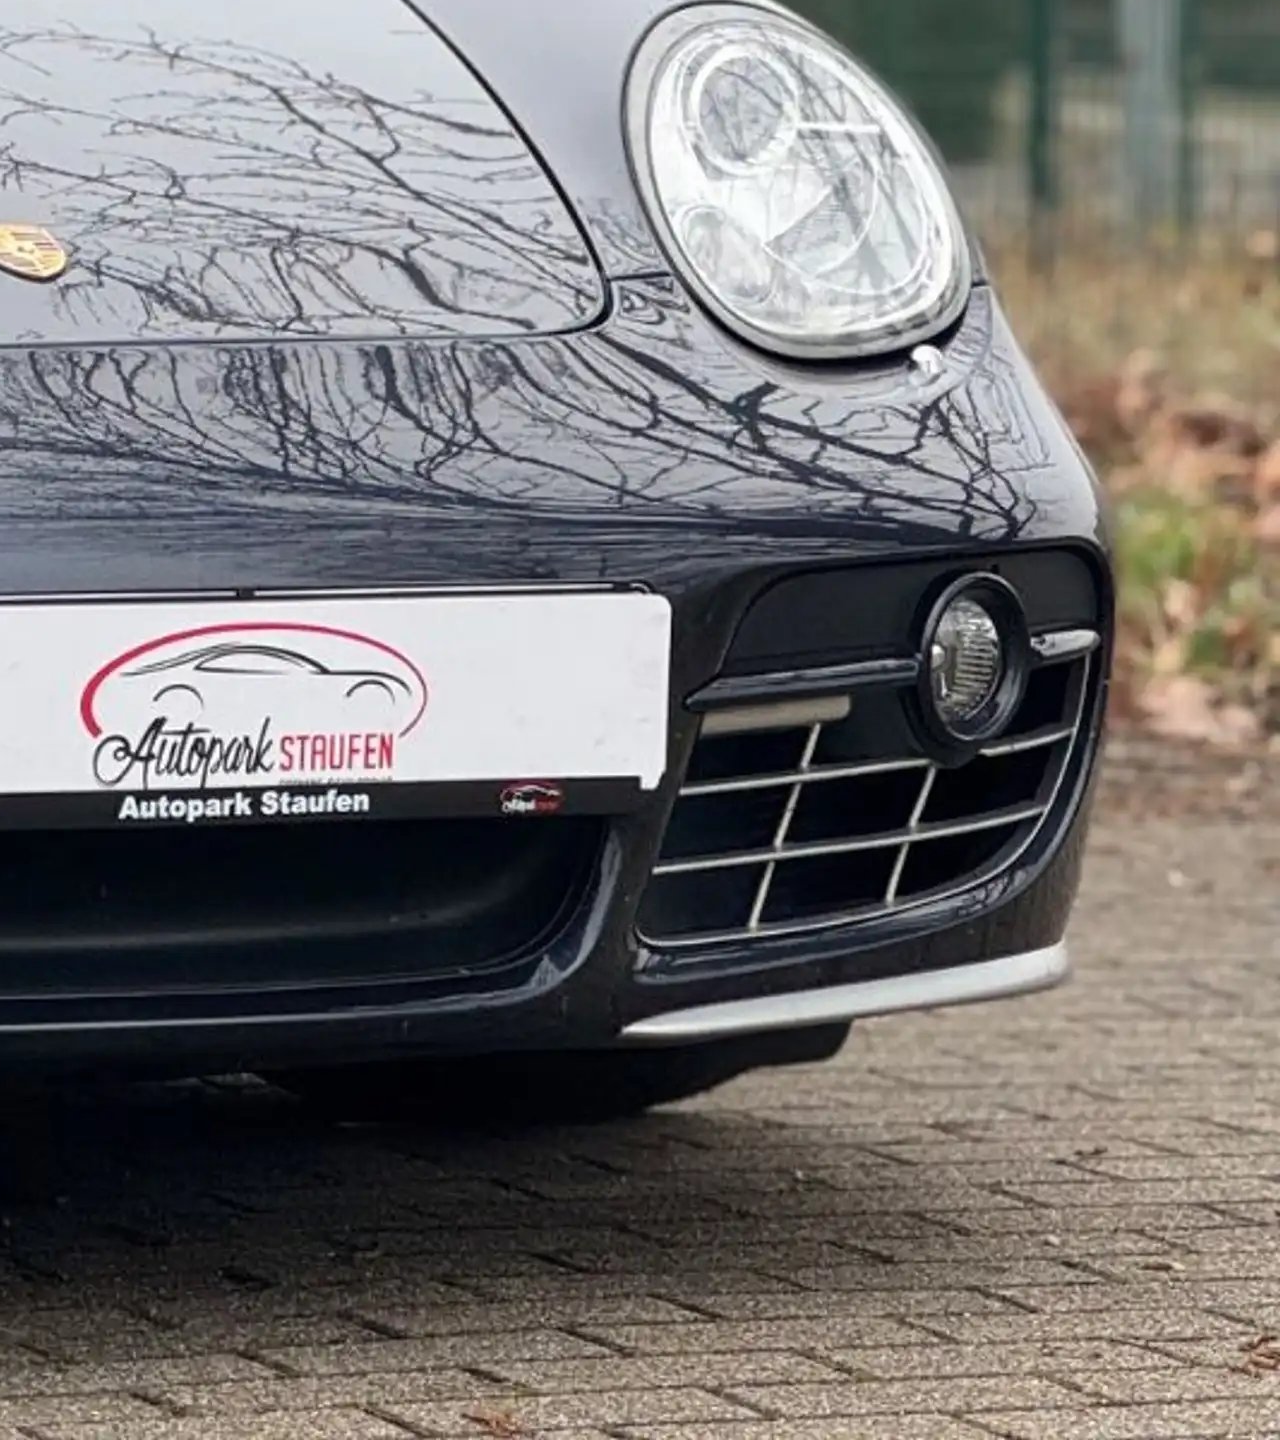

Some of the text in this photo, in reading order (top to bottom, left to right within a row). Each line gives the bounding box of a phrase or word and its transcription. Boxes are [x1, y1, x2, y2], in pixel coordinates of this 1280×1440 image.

[93, 716, 394, 789] Autopark STAUFEN
[119, 790, 371, 821] Autopark Staufen
